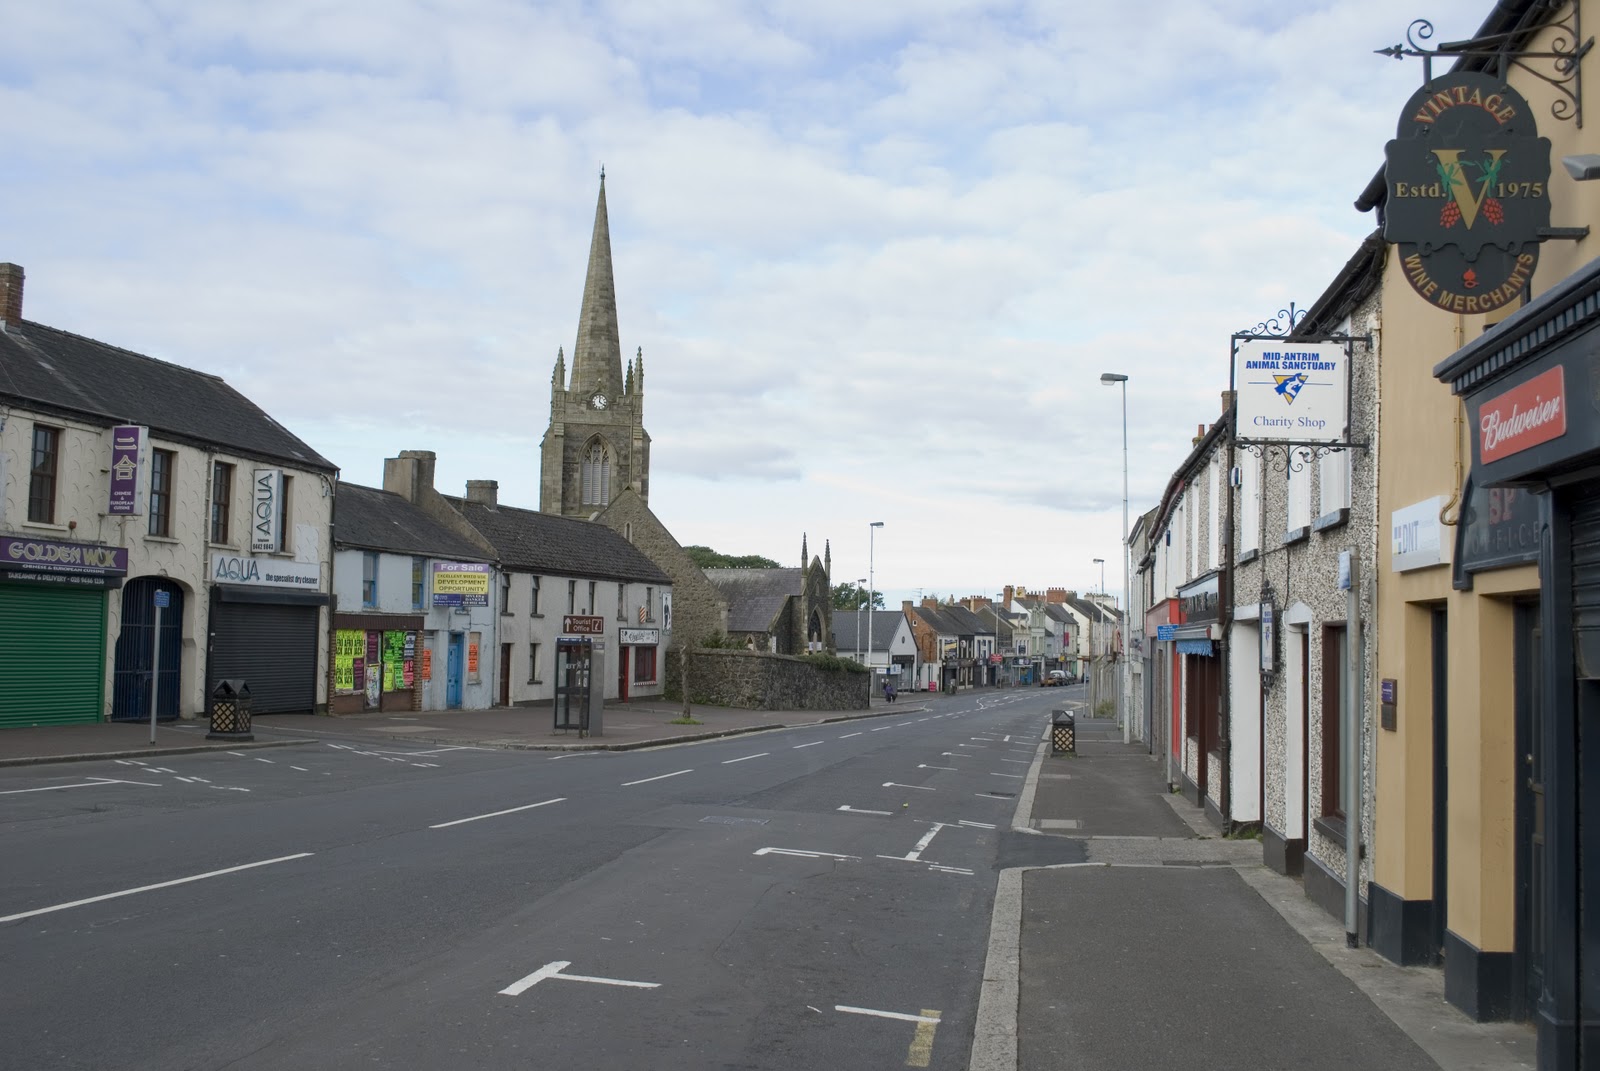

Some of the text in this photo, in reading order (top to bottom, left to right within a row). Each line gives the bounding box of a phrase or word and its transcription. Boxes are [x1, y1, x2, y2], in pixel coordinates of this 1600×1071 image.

[1413, 85, 1516, 125] VINTAGE
[1395, 182, 1447, 198] Estd.
[1497, 182, 1543, 198] 1975
[1404, 253, 1534, 312] WINE MERCHANTS
[1262, 352, 1320, 361] MID-ANTRIM
[1246, 361, 1336, 370] ANIMAL SANCTUARY
[1253, 416, 1326, 430] Charity Shop
[1481, 395, 1560, 452] Budweiser
[256, 473, 273, 536] AQUA
[8, 542, 118, 568] GOLDEN WOK
[8, 572, 36, 580] TAKEAWAY
[42, 574, 67, 582] DELIVERY
[216, 557, 260, 582] AQUA
[265, 573, 273, 581] the
[274, 574, 295, 583] specialist
[302, 576, 318, 584] cleaner
